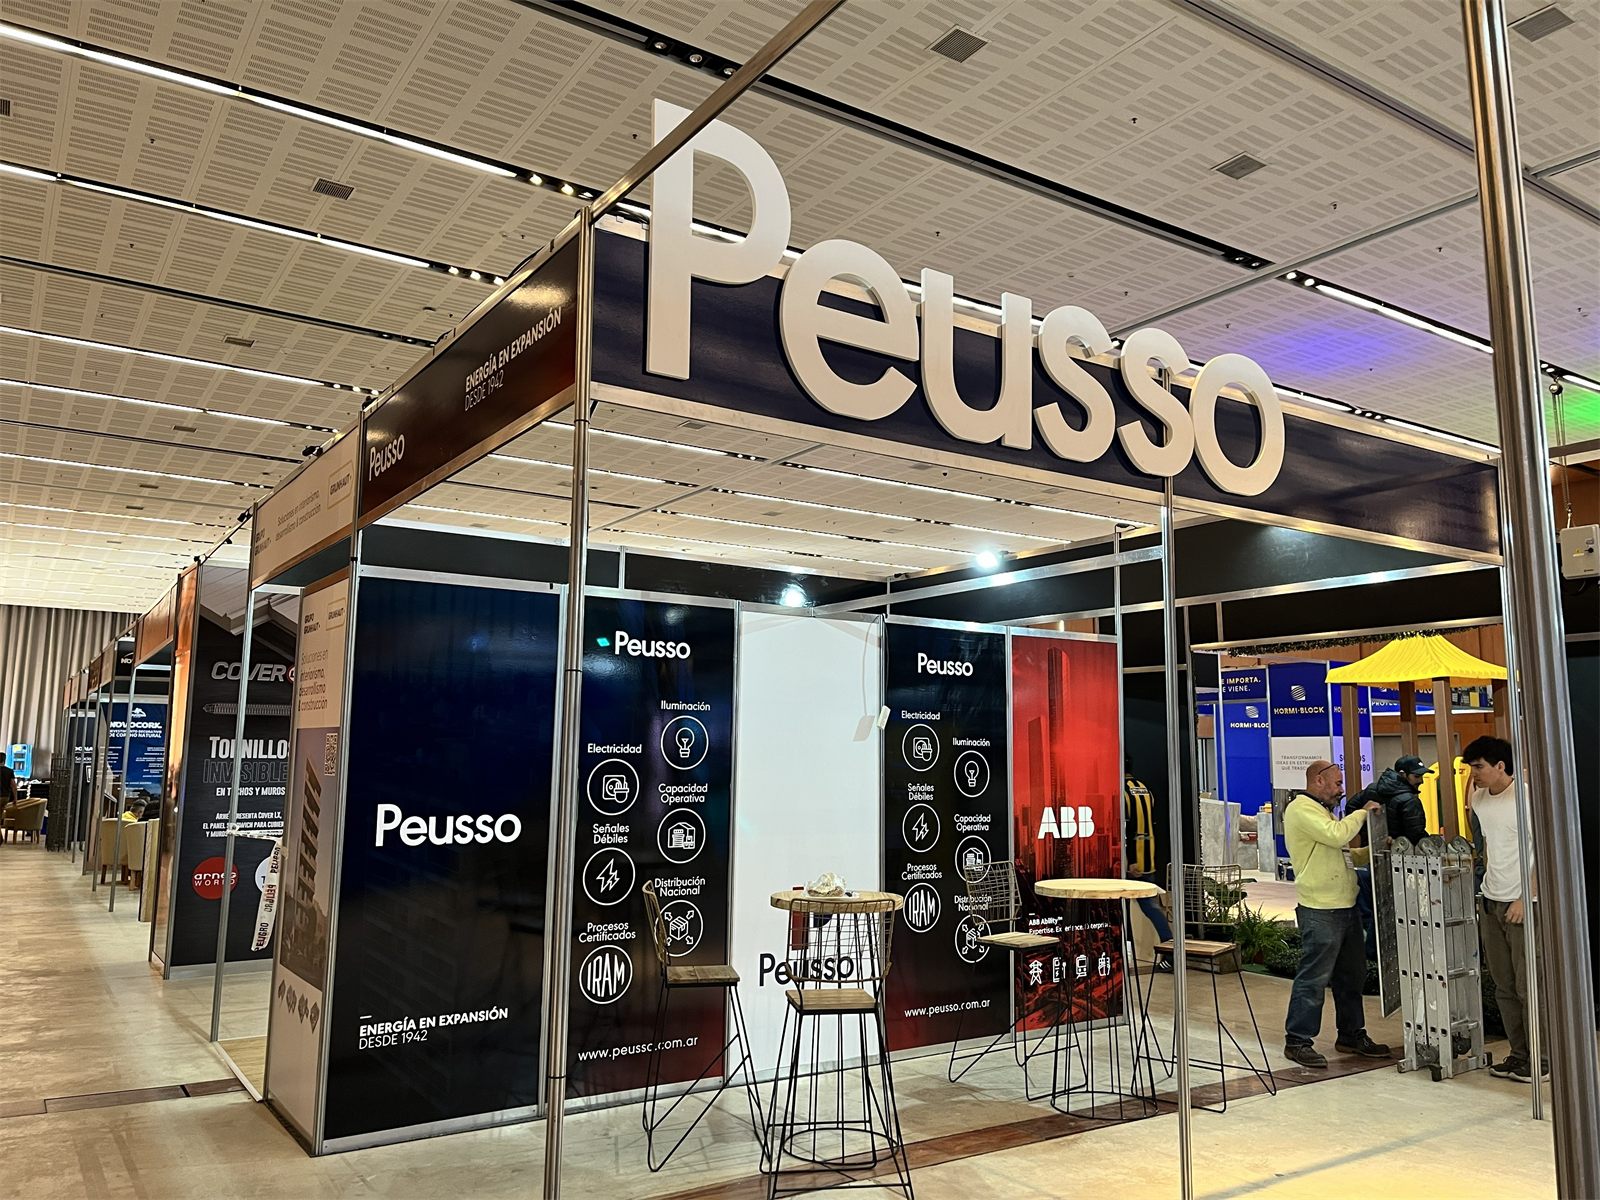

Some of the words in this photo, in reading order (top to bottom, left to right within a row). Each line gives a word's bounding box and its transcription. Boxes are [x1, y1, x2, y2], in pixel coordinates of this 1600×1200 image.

[646, 98, 1286, 497] Peusso
[466, 353, 497, 392] ENERGÍA
[498, 347, 509, 369] EN
[511, 306, 562, 360] EXPANSIÓN
[464, 385, 486, 412] DESDE
[487, 369, 504, 396] 1942
[368, 434, 405, 481] Peusso
[614, 630, 691, 659] Peusso
[917, 652, 974, 677] Peusso
[211, 661, 287, 682] COVER
[1226, 676, 1261, 685] IMPORTA.
[661, 700, 711, 712] Iluminación
[901, 710, 940, 721] Electricidad
[209, 736, 290, 759] TONILLO
[587, 743, 642, 754] Electricidad
[952, 737, 991, 747] Iluminación
[203, 759, 288, 783] INVSIBLE
[216, 787, 225, 796] EN
[227, 786, 253, 796] THOS
[254, 786, 260, 796] Y
[261, 786, 286, 796] MUROS
[658, 783, 708, 795] Capacidad
[907, 783, 934, 792] Señales
[660, 793, 705, 806] Operativa
[908, 791, 934, 801] Débiles
[375, 803, 522, 847] Peusso
[954, 814, 991, 824] Capacidad
[1038, 806, 1095, 839] ABB
[592, 823, 630, 834] Señales
[956, 823, 989, 832] Operativa
[593, 833, 628, 844] Débiles
[907, 863, 937, 873] Procesos
[654, 876, 706, 888] Distribución
[901, 870, 942, 881] Certificados
[659, 885, 700, 897] Nacional
[908, 889, 935, 927] IRAM
[587, 922, 629, 933] Procesos
[578, 930, 636, 943] Certificados
[587, 952, 625, 998] IRAM
[904, 1000, 990, 1017] www.peusso.com.ar
[359, 1016, 416, 1037] ENERGÍA
[419, 1015, 436, 1029] EN
[439, 1006, 509, 1026] EXPANSIÓN
[359, 1030, 398, 1050] DESDE
[401, 1029, 428, 1044] 1942
[578, 1037, 698, 1061] www.peusso.com.ar
